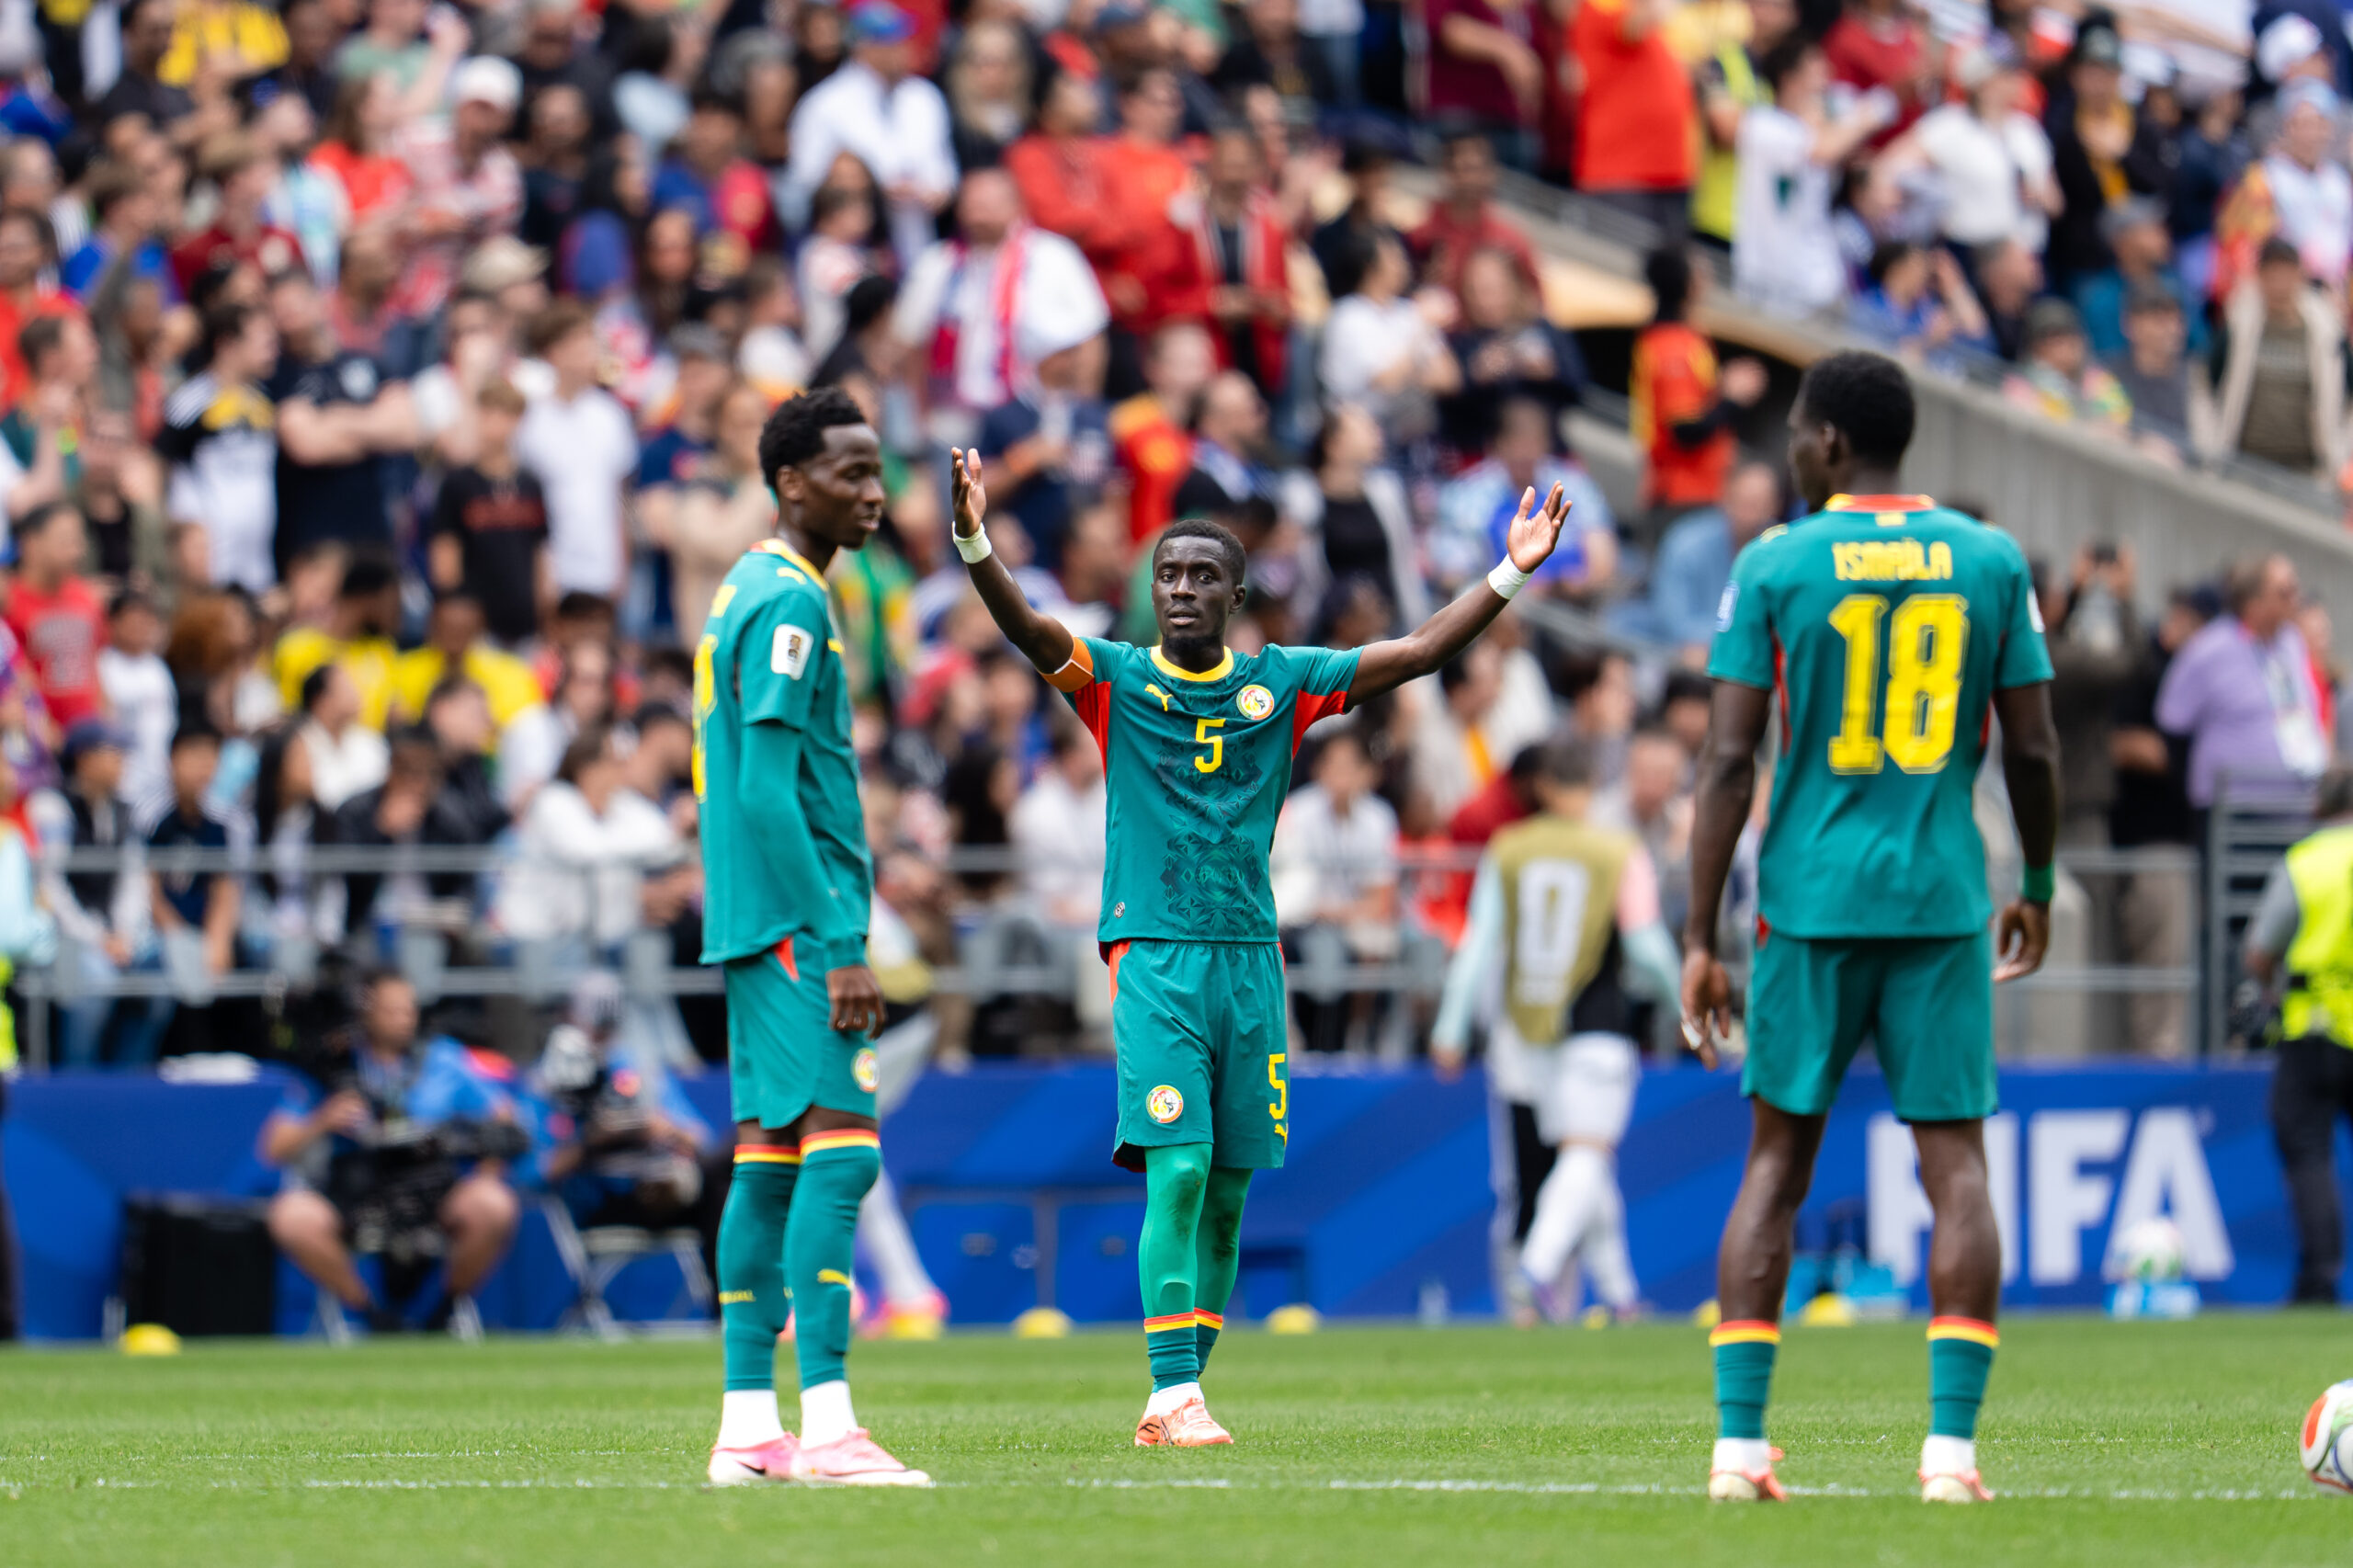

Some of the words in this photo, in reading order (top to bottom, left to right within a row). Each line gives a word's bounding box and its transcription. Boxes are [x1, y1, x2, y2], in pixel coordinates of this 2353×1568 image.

[1828, 593, 1971, 775] 18
[1195, 718, 1226, 773] 5
[1267, 1053, 1287, 1119] 5
[1867, 1108, 2235, 1283] FIFA
